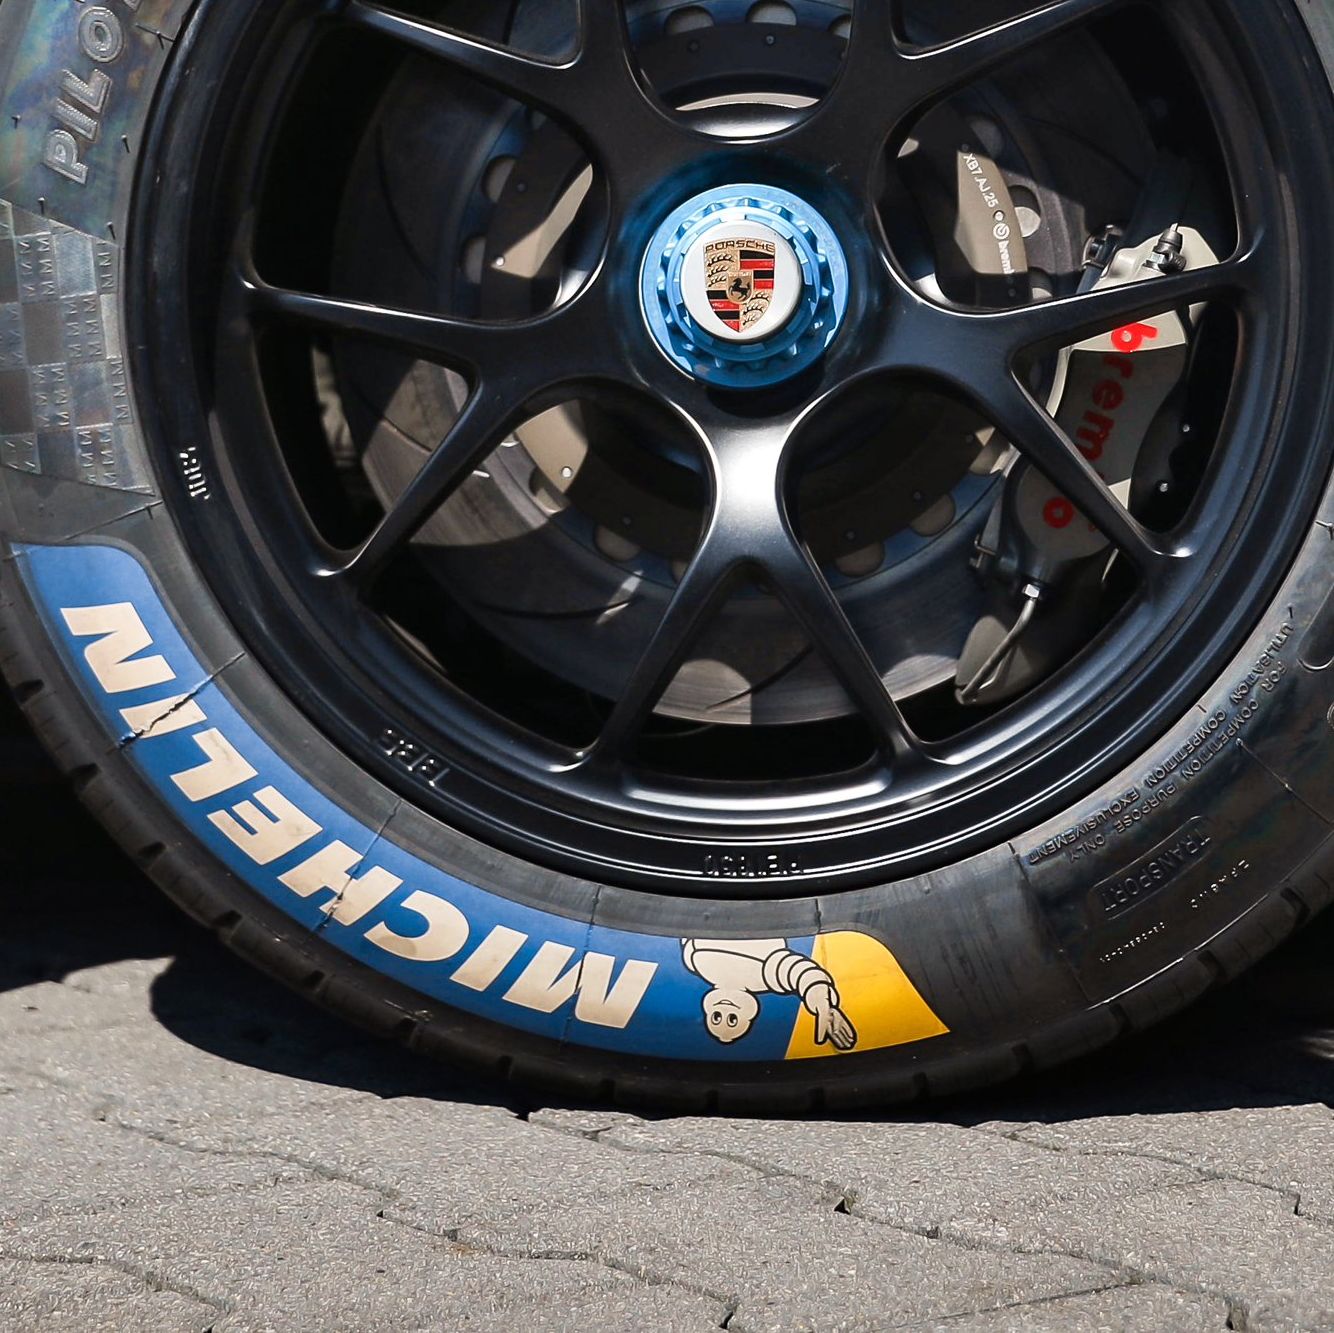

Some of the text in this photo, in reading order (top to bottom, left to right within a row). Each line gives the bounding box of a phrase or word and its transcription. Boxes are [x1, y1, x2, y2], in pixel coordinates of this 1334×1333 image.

[705, 239, 776, 253] PORSCHE
[1042, 322, 1158, 532] bremo
[59, 601, 659, 1029] MICHELIN
[1029, 622, 1294, 866] UTILISATION COMPETITION EXCLUSIVEMENT
[1070, 660, 1288, 863] FOR COMPETITION PURPOSE ONLY
[1101, 828, 1211, 912] TRANSPORT
